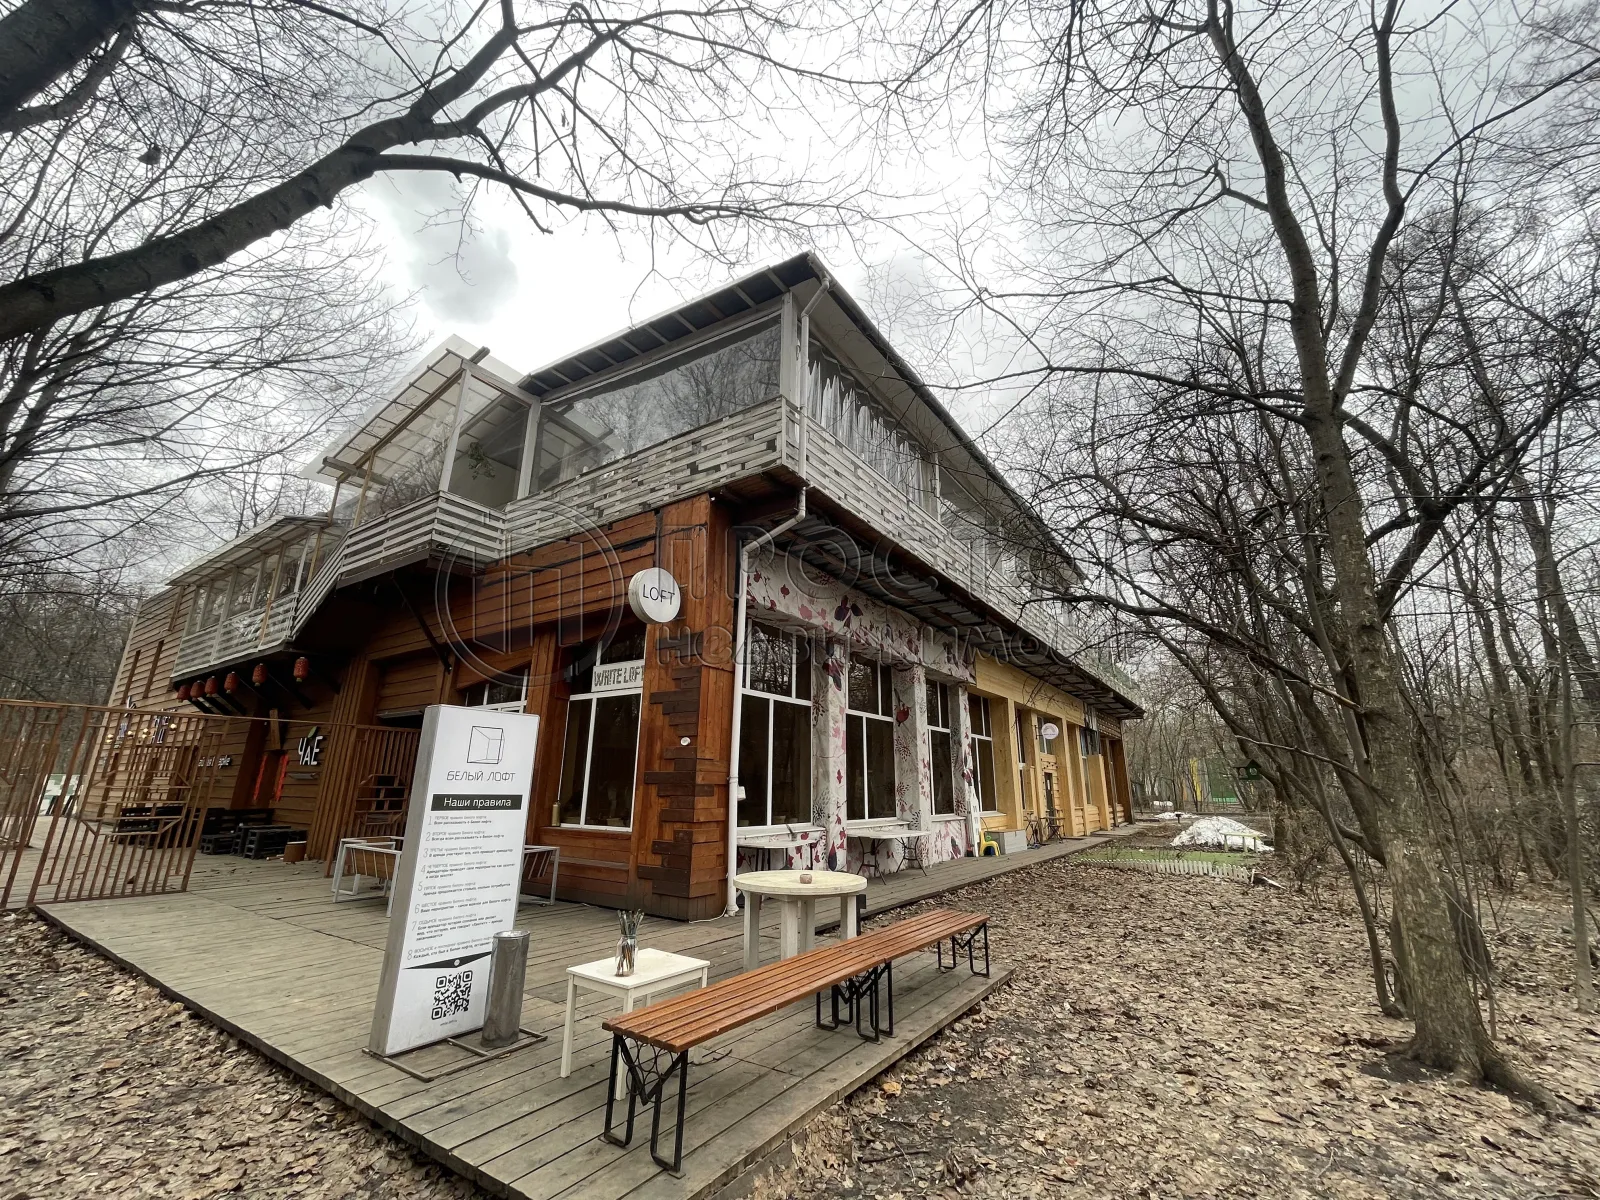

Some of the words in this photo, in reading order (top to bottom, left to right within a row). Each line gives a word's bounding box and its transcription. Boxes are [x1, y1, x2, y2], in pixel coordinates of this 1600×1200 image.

[643, 584, 675, 605] LOFT
[594, 667, 622, 686] WHITE
[446, 770, 484, 781] БЕЛЫЙ
[486, 771, 516, 782] ЛОФТ
[444, 798, 470, 807] Наши
[472, 798, 512, 809] правила
